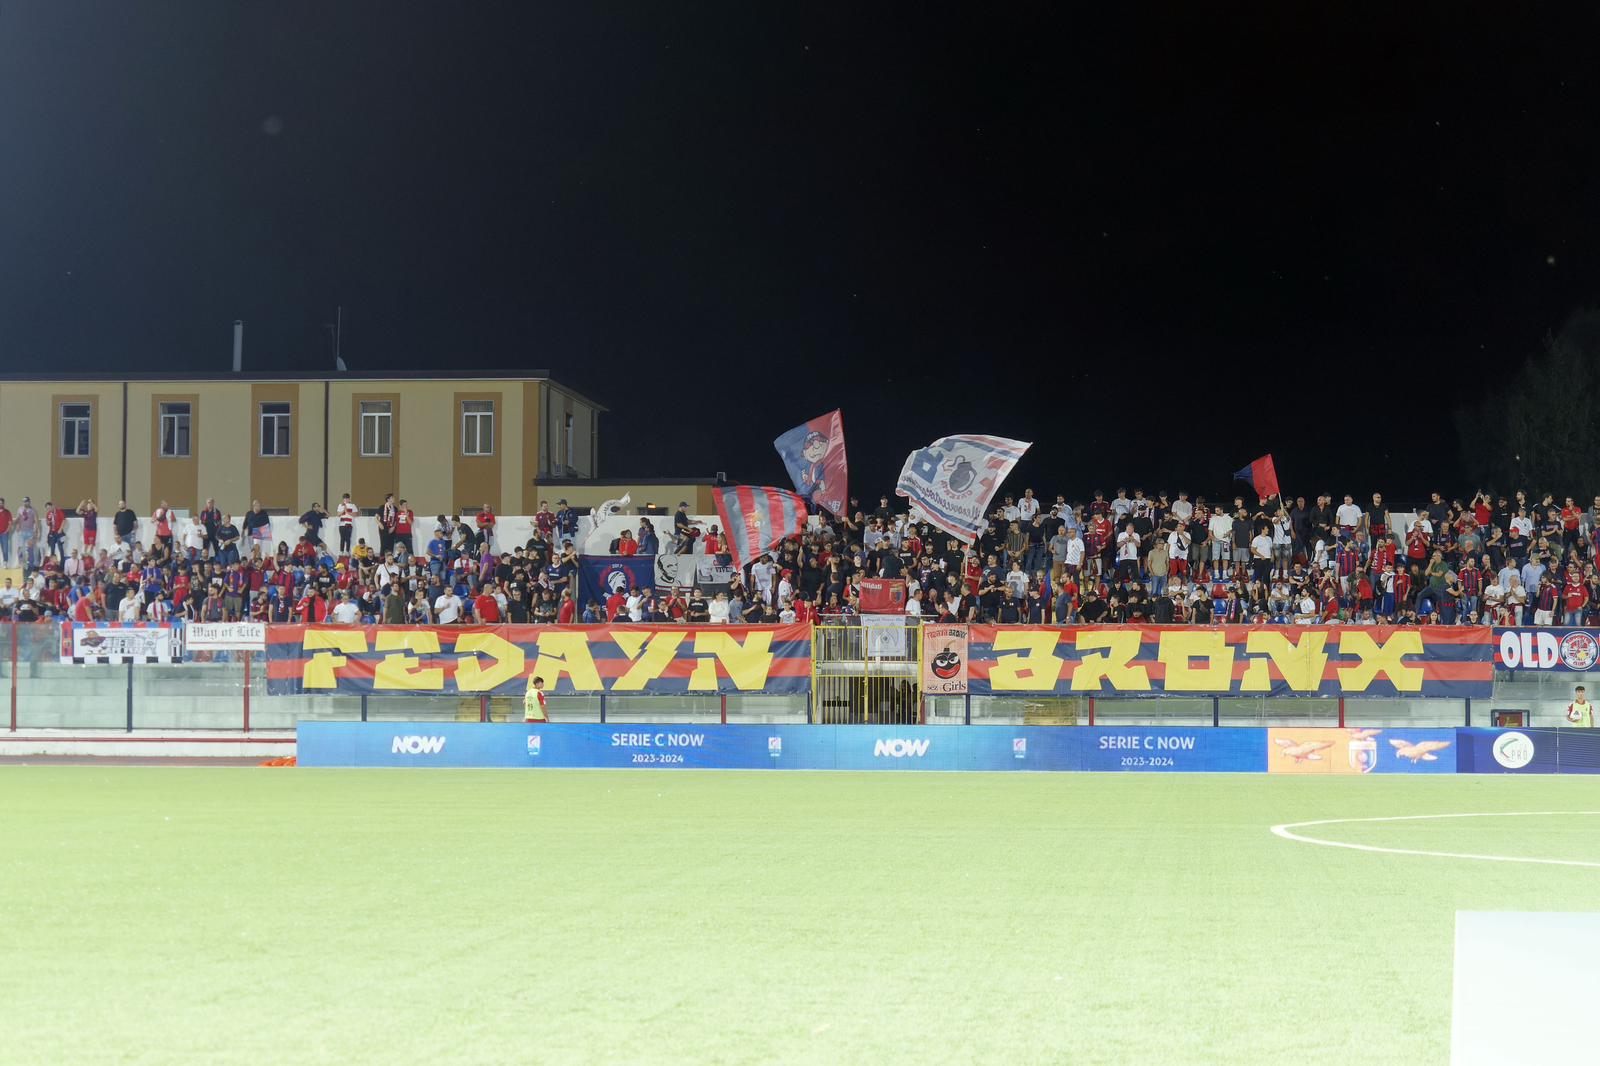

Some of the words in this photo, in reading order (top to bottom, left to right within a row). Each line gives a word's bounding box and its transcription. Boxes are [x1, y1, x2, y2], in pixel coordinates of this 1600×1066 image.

[192, 626, 218, 640] Way
[221, 627, 233, 638] of
[236, 626, 262, 638] Life
[1500, 631, 1559, 669] OLD
[302, 630, 774, 692] FEDAYN
[942, 681, 967, 692] Girls
[391, 735, 446, 754] NOW
[611, 733, 651, 747] SERIE
[654, 733, 664, 747] C
[668, 733, 705, 747] NOW
[1099, 736, 1140, 750] SERIE
[1143, 736, 1153, 750] C
[1157, 736, 1195, 750] NOW
[873, 738, 931, 758] NOW
[631, 753, 684, 764] 2023-2024
[1121, 757, 1174, 767] 2023-2024
